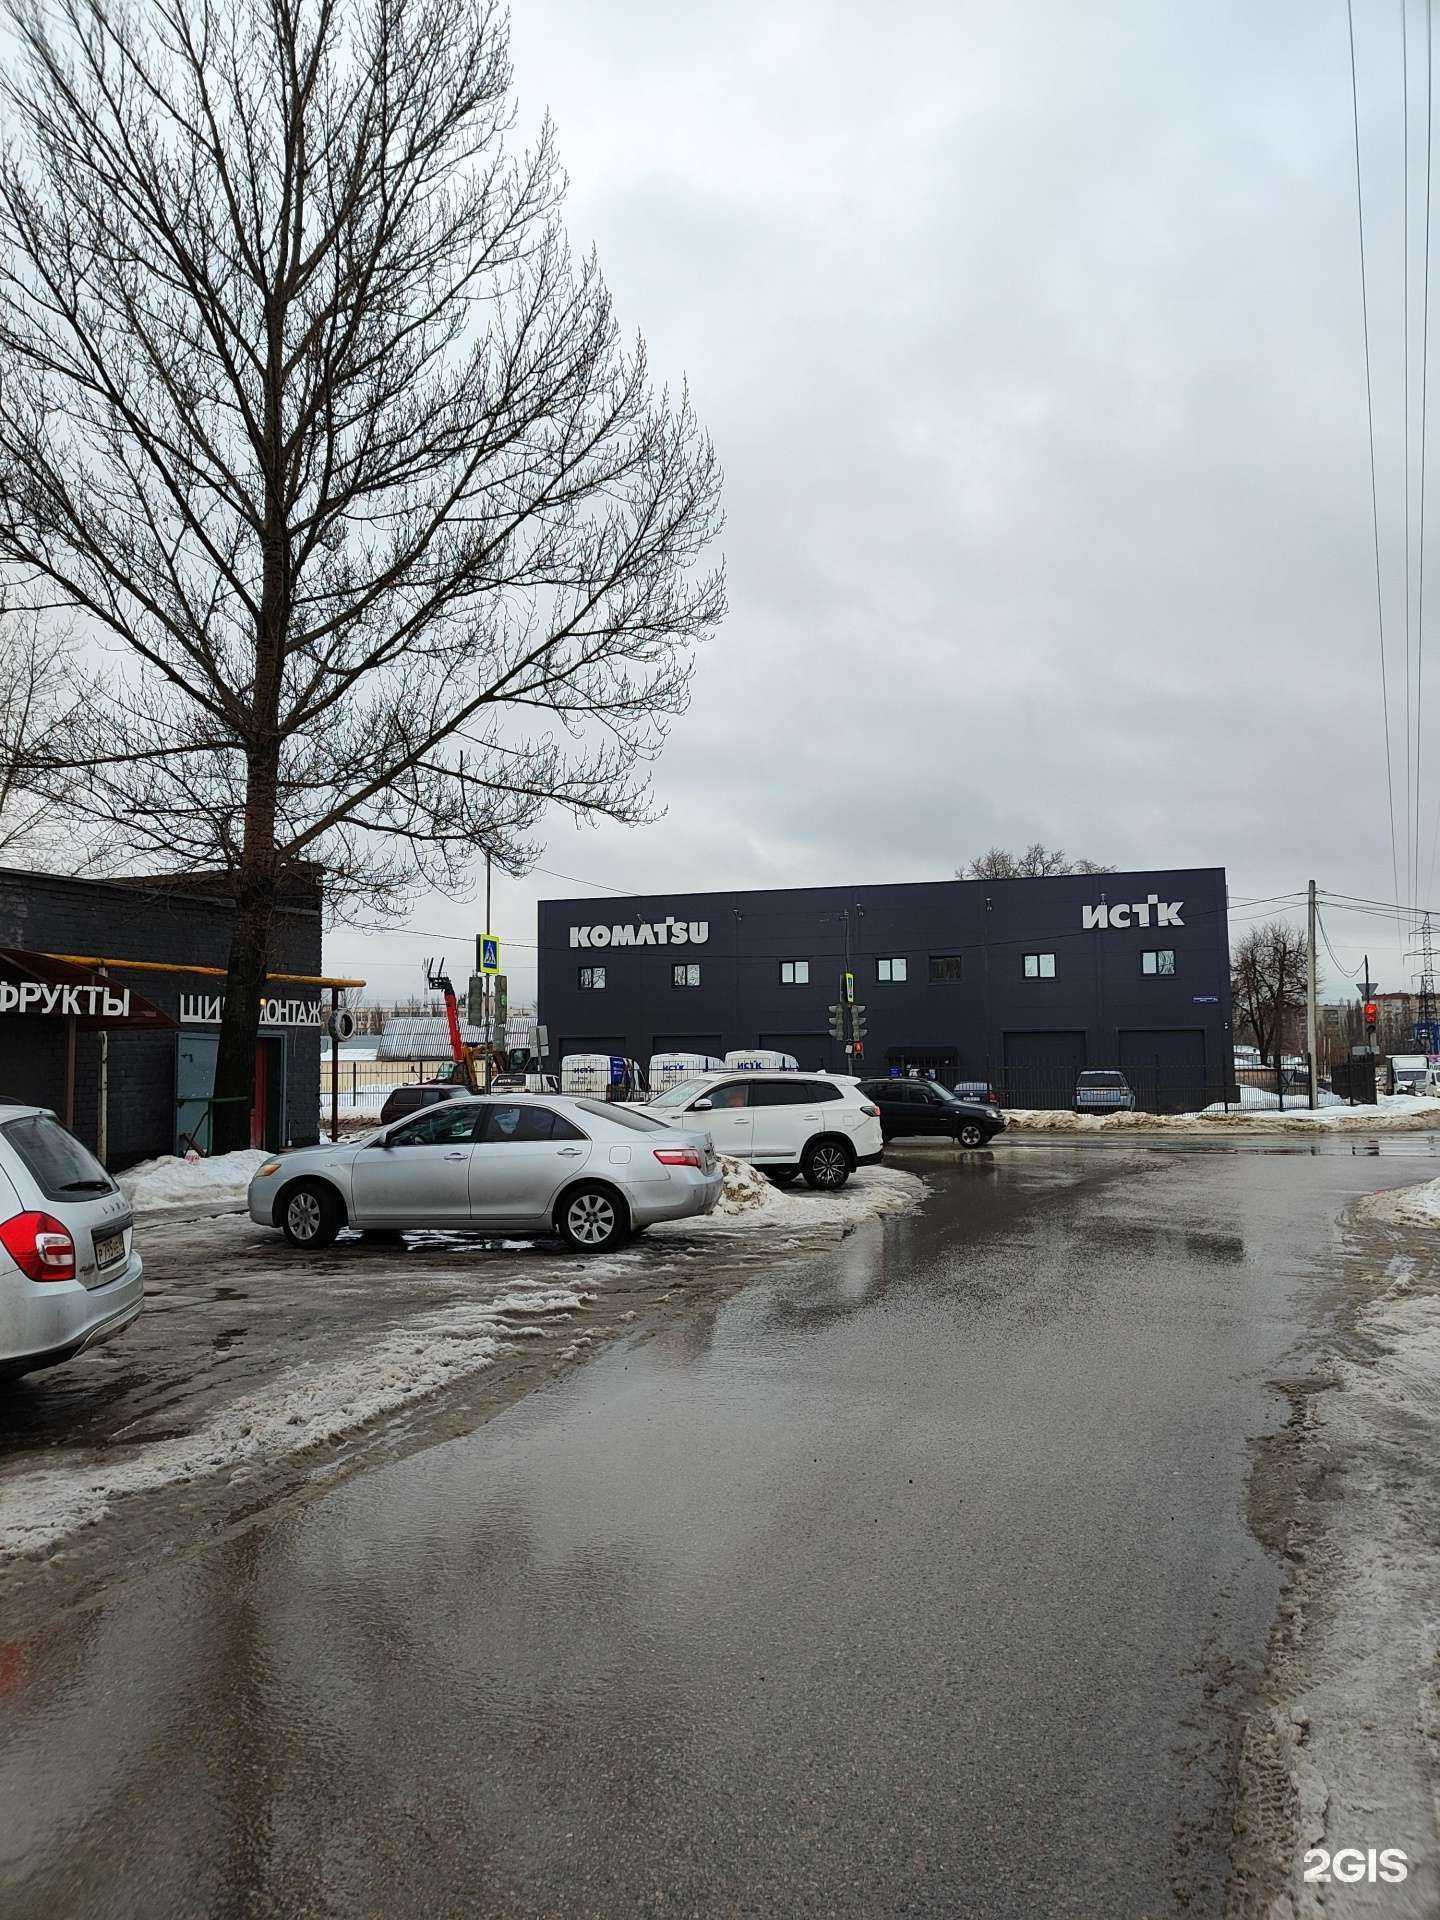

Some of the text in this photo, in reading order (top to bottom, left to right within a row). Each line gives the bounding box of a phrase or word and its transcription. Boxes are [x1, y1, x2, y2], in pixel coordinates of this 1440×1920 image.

[1082, 894, 1185, 929] ИСТК
[569, 916, 709, 948] KOMATSU
[0, 981, 130, 1017] ФРУКТЫ
[179, 992, 322, 1026] ШИОНТАЖ
